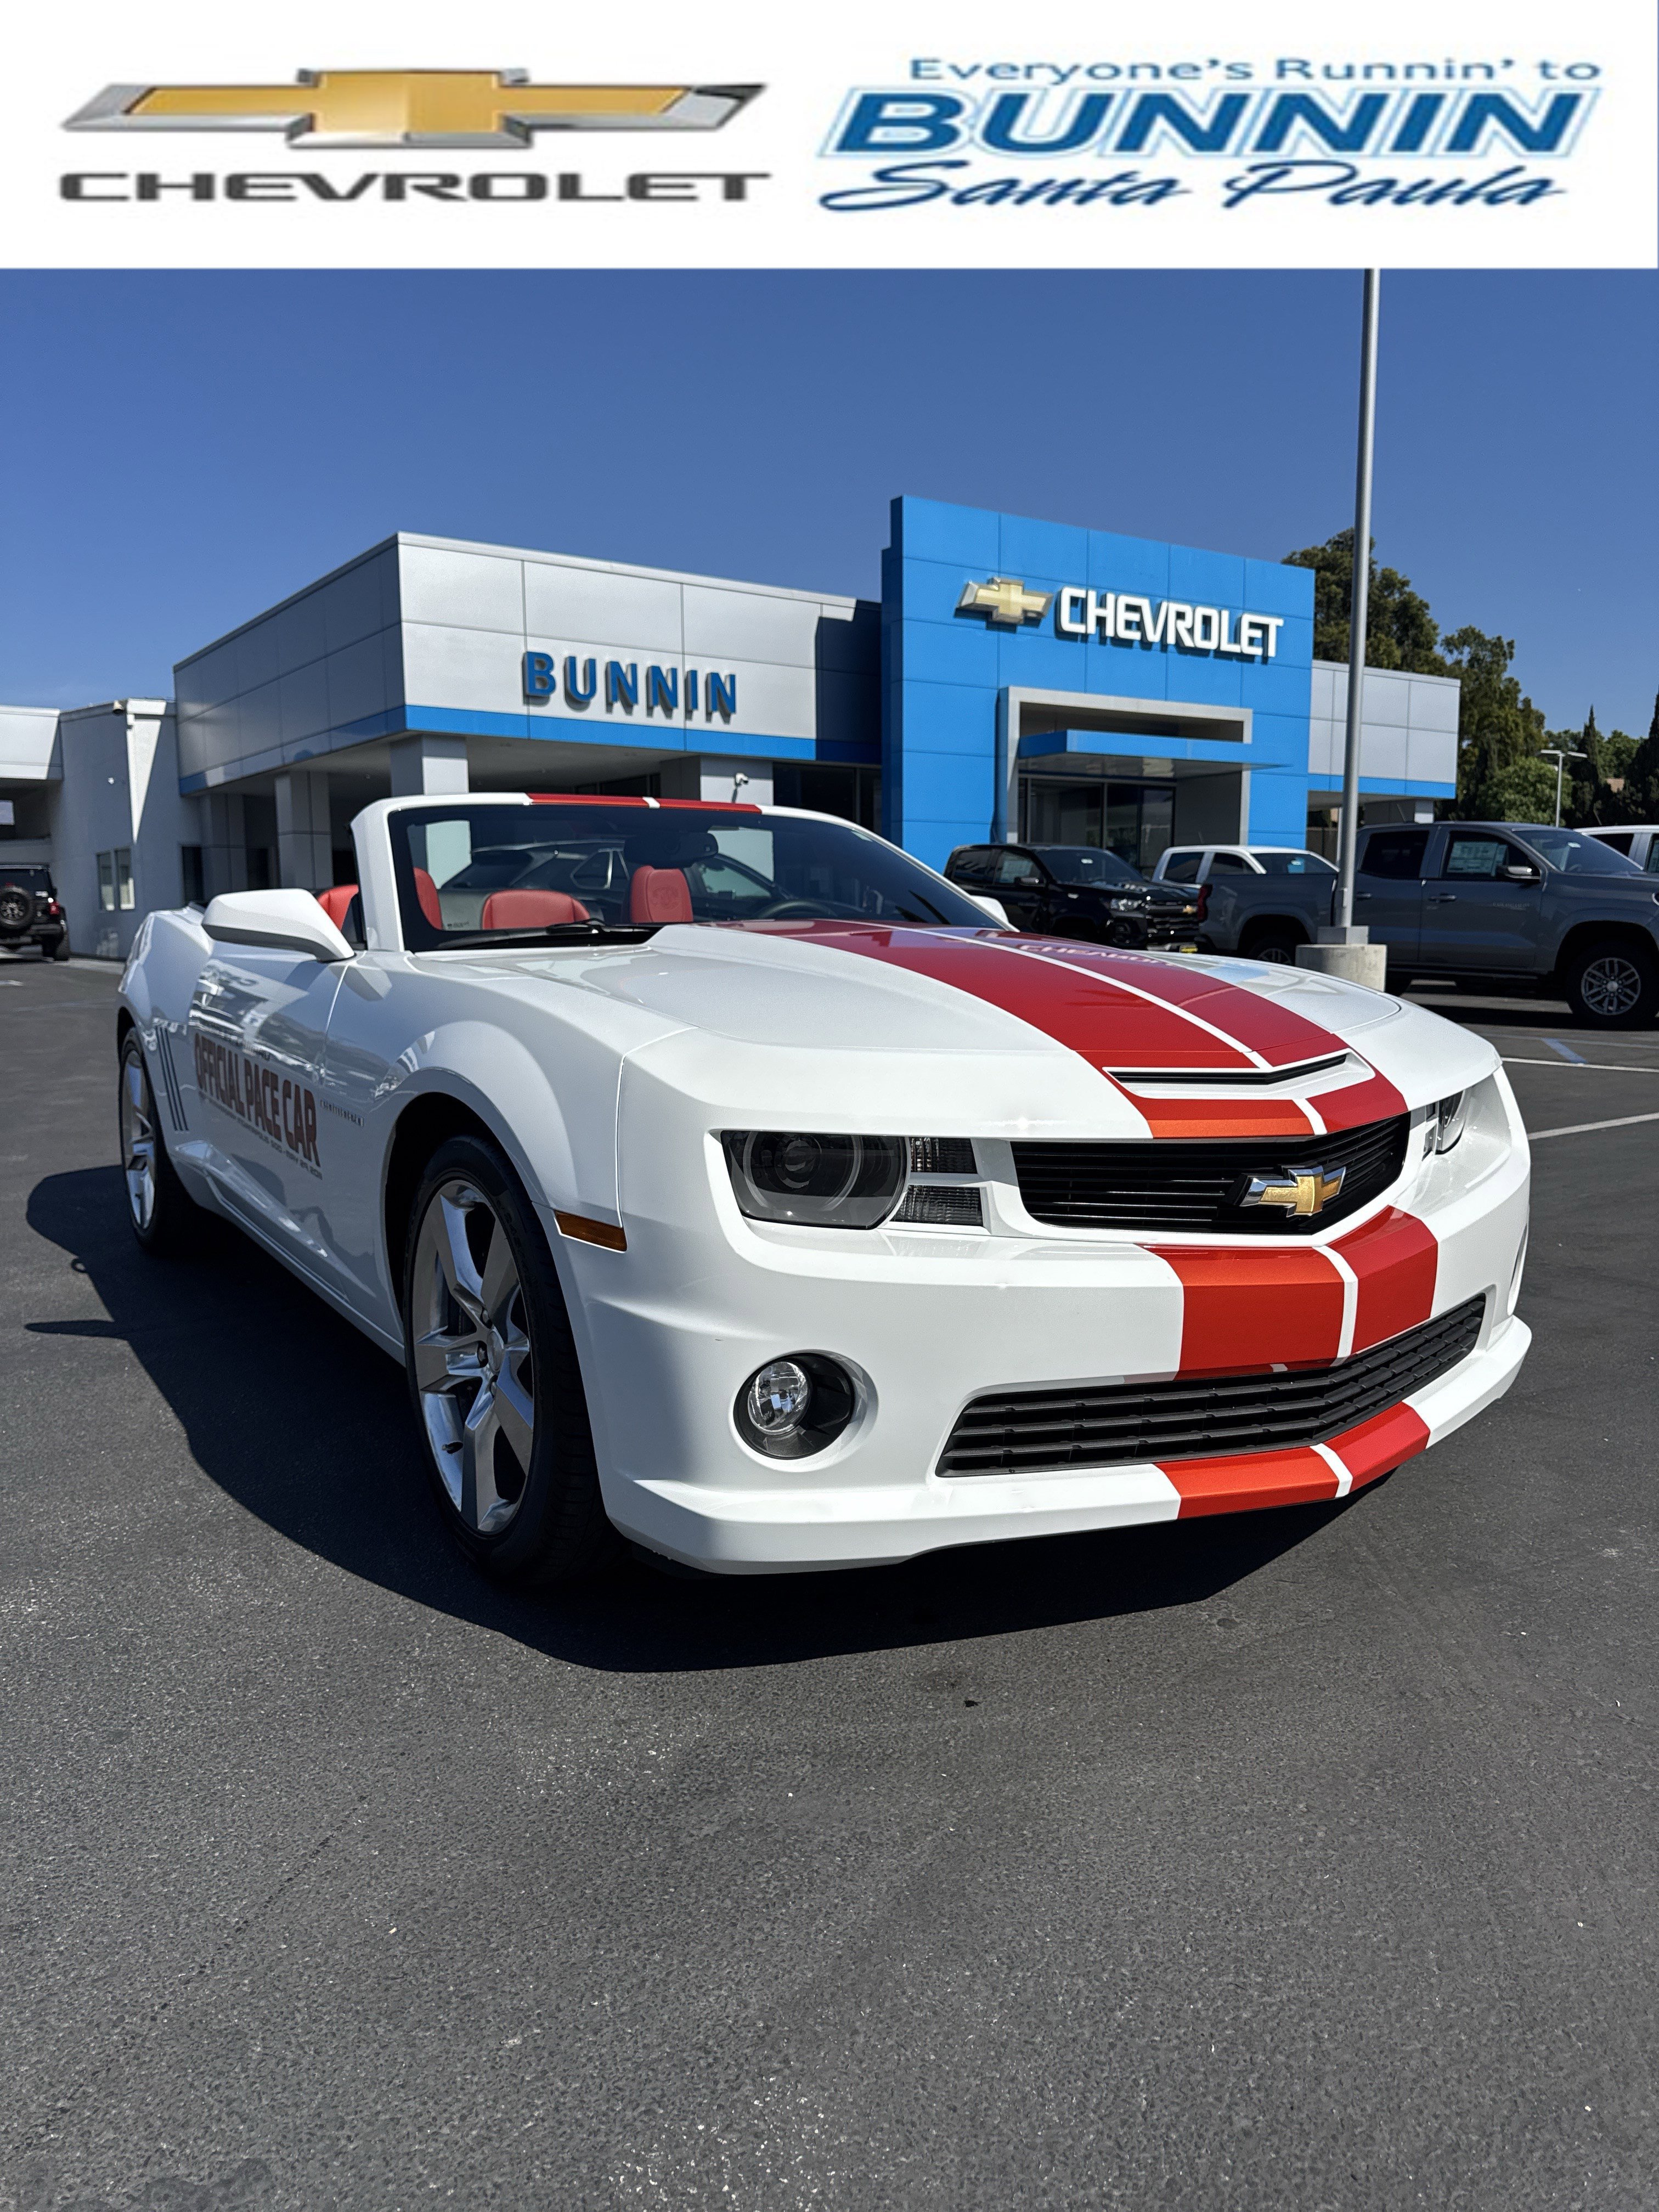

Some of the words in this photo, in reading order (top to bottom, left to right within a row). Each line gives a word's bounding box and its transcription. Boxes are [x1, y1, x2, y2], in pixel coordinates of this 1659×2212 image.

[1060, 586, 1284, 658] CHEVROLET
[522, 651, 736, 715] BUNNIN
[244, 1058, 283, 1142] PACE
[283, 1080, 321, 1168] CAR
